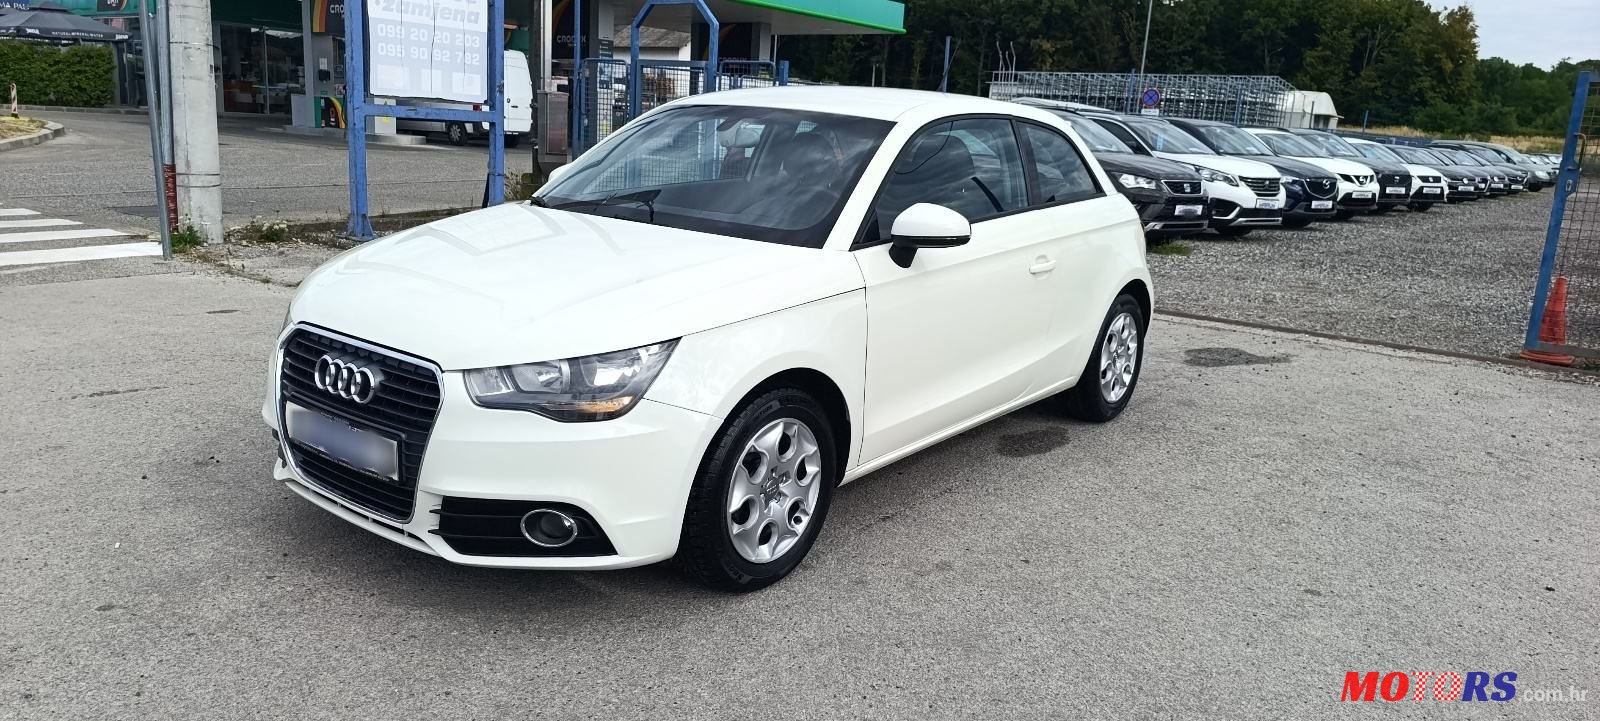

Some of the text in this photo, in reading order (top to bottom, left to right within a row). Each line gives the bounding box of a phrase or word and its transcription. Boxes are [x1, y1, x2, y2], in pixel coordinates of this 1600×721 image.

[329, 4, 344, 14] CRO
[377, 23, 480, 48] 099 20 20 203
[408, 45, 428, 60] 90
[433, 48, 450, 62] 92
